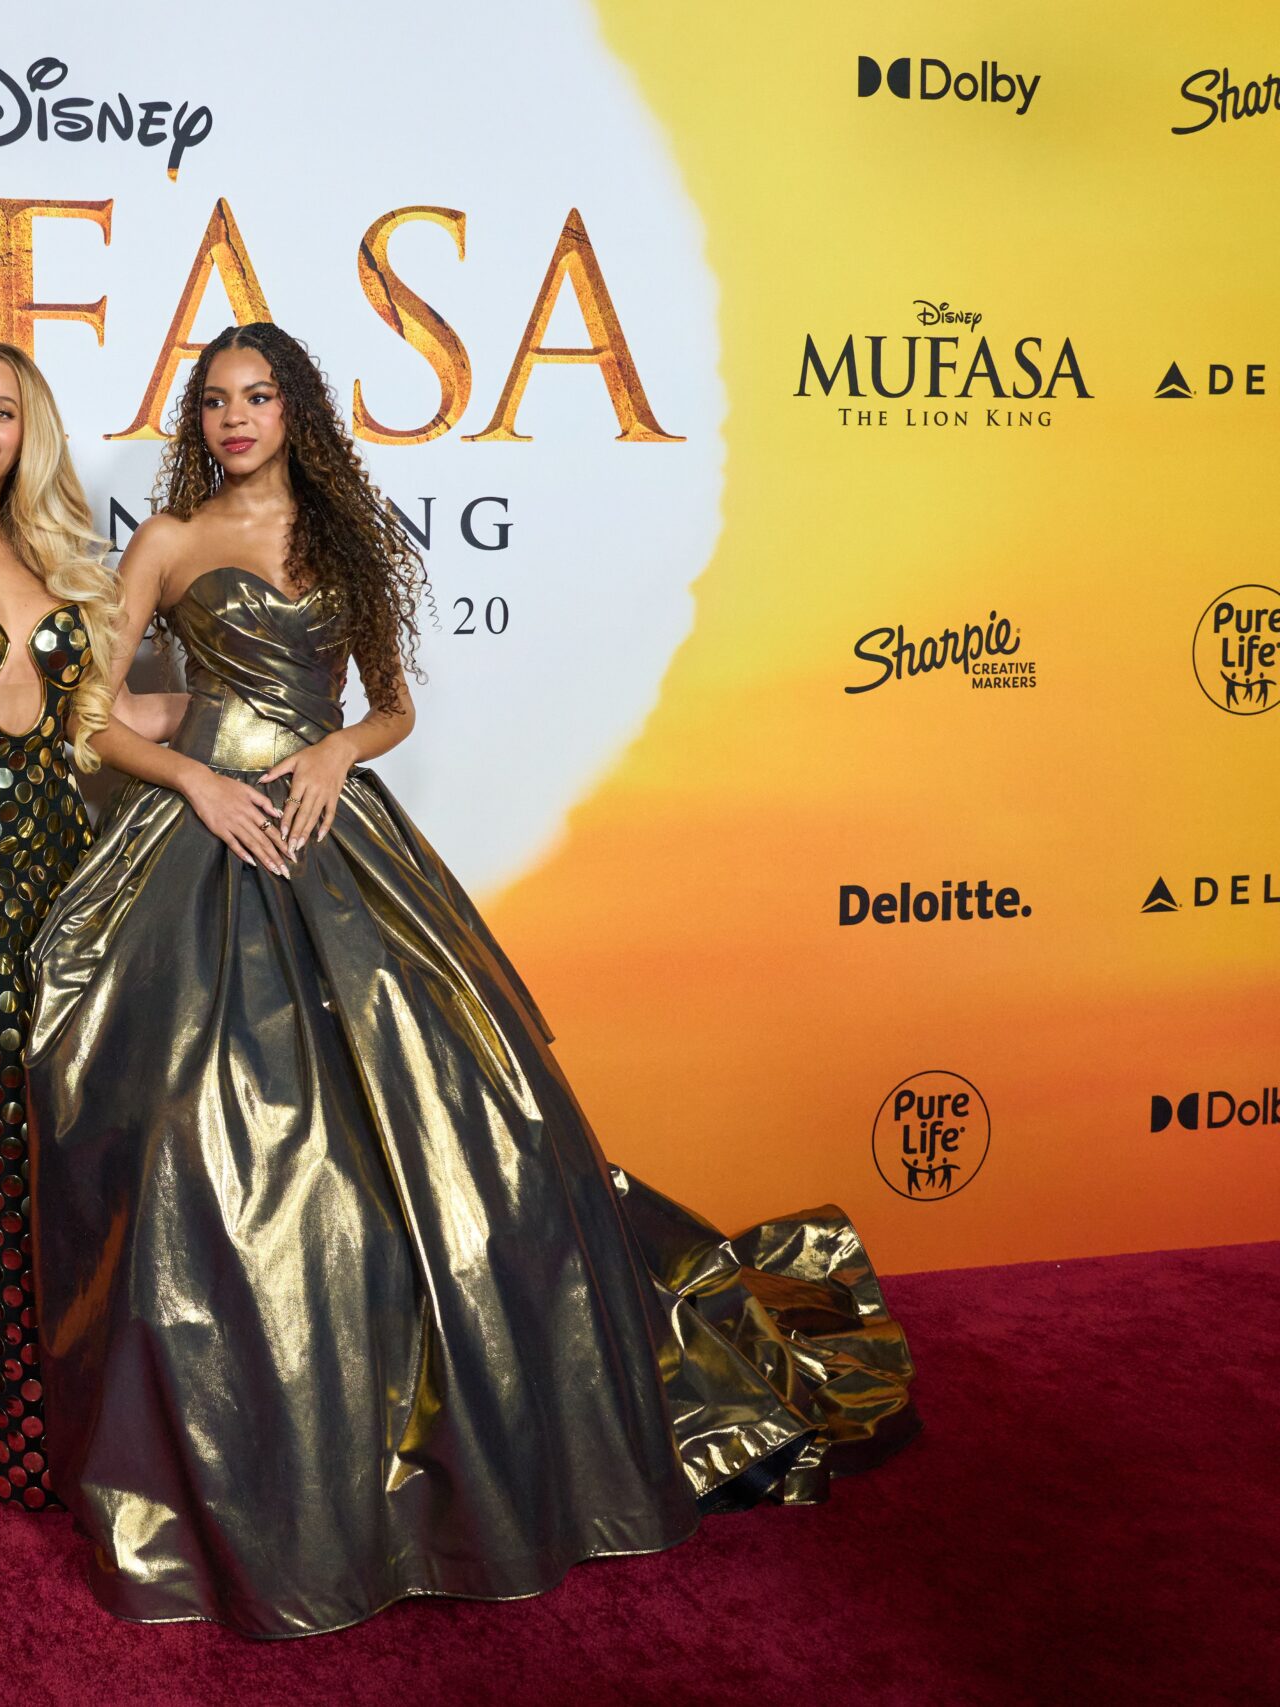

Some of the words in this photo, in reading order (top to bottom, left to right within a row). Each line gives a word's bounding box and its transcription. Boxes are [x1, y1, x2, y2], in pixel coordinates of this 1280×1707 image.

[921, 58, 1041, 116] Dolby
[793, 333, 1095, 400] MUFASA
[453, 596, 510, 635] 20
[1214, 602, 1280, 633] Pure
[844, 610, 1021, 694] Sharpie
[972, 662, 1037, 675] CREATIVE
[1221, 635, 1276, 676] Life
[972, 676, 1037, 689] MARKERS
[1194, 873, 1280, 907] DEL
[894, 1089, 970, 1122] Pure
[902, 1121, 962, 1161] Life
